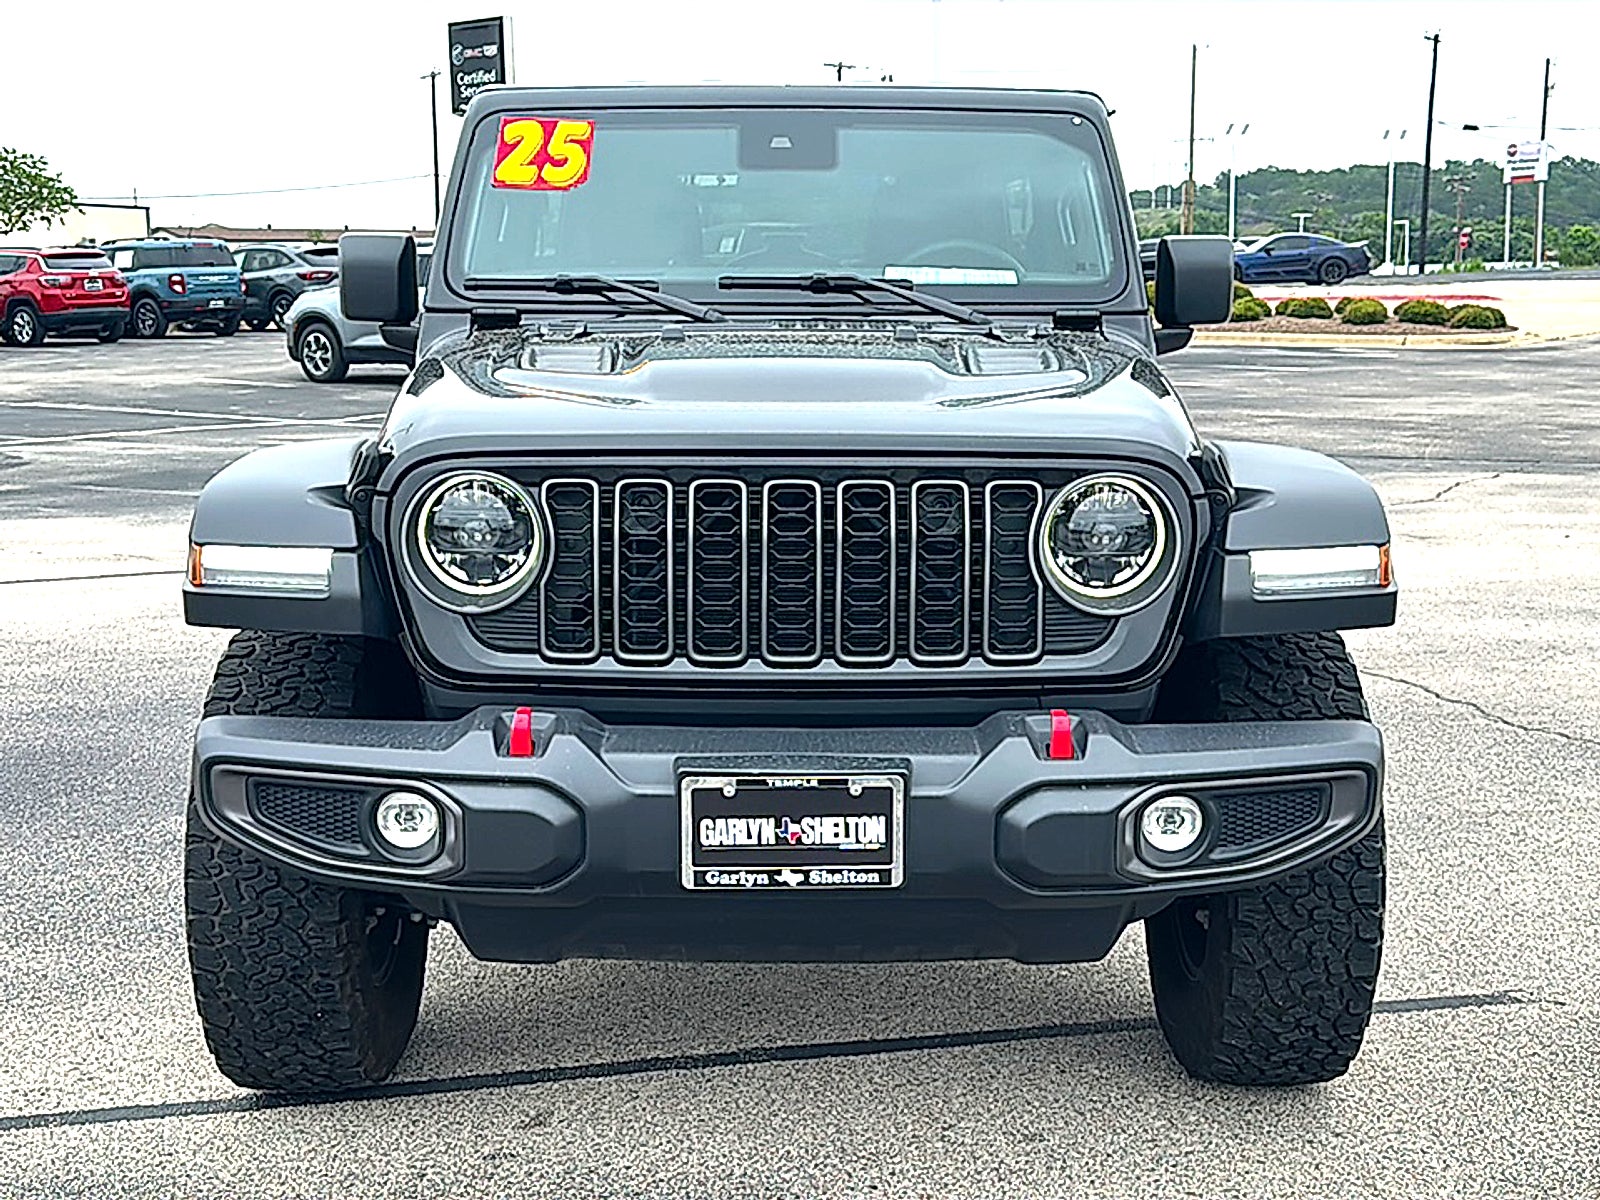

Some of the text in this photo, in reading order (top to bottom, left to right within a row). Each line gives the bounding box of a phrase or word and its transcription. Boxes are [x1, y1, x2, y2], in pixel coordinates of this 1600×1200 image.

[456, 68, 496, 85] Certified
[495, 120, 591, 187] 25
[766, 779, 818, 787] TEMPLE
[700, 816, 886, 845] GARLYN SHELTON
[705, 870, 880, 887] Garlyn Shelton
